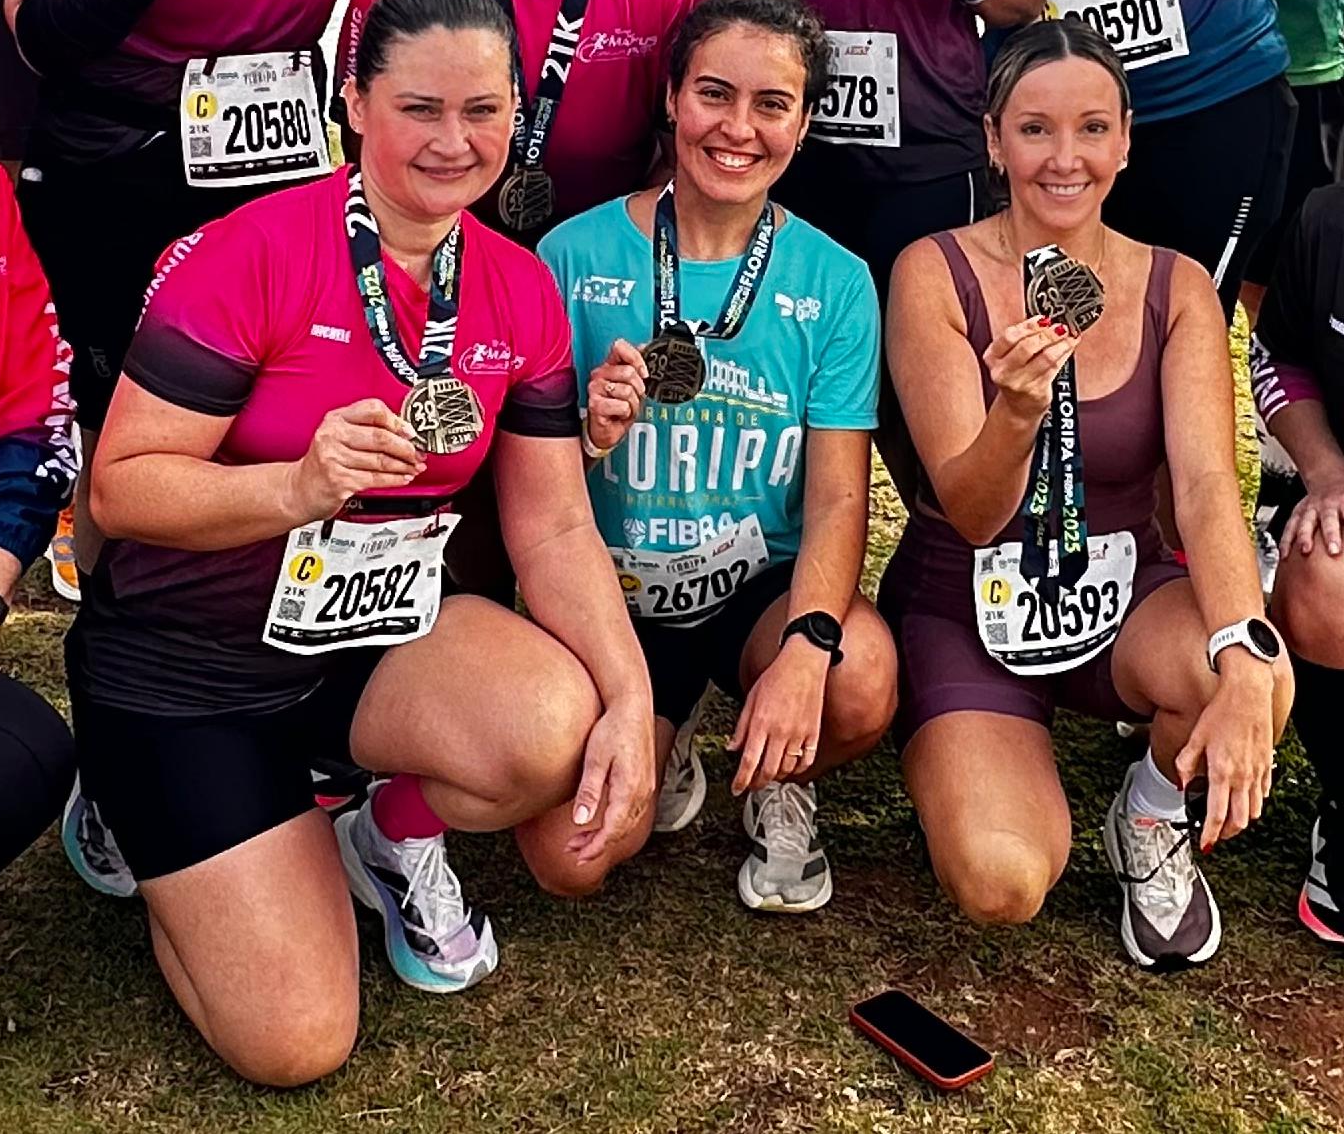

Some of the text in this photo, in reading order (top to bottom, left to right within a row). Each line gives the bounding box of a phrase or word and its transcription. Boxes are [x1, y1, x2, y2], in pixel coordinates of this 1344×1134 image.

[542, 10, 585, 84] 21K
[195, 94, 209, 118] C
[222, 98, 311, 156] 20580
[188, 124, 210, 135] 21K
[344, 172, 380, 238] 21K
[740, 224, 774, 290] FLORIPA
[361, 265, 385, 307] 2025
[418, 316, 459, 360] 21K
[648, 352, 669, 367] 20
[413, 401, 436, 417] 20
[416, 414, 441, 432] 25
[1057, 379, 1074, 462] FLORIPA
[450, 432, 473, 445] 21K
[648, 512, 741, 546] FIBRA
[1062, 505, 1081, 555] 2025
[296, 556, 316, 581] C
[647, 557, 751, 614] 26702
[283, 586, 307, 598] 21K
[314, 559, 422, 623] 20582
[990, 579, 1002, 605] C
[1016, 579, 1120, 644] 20593
